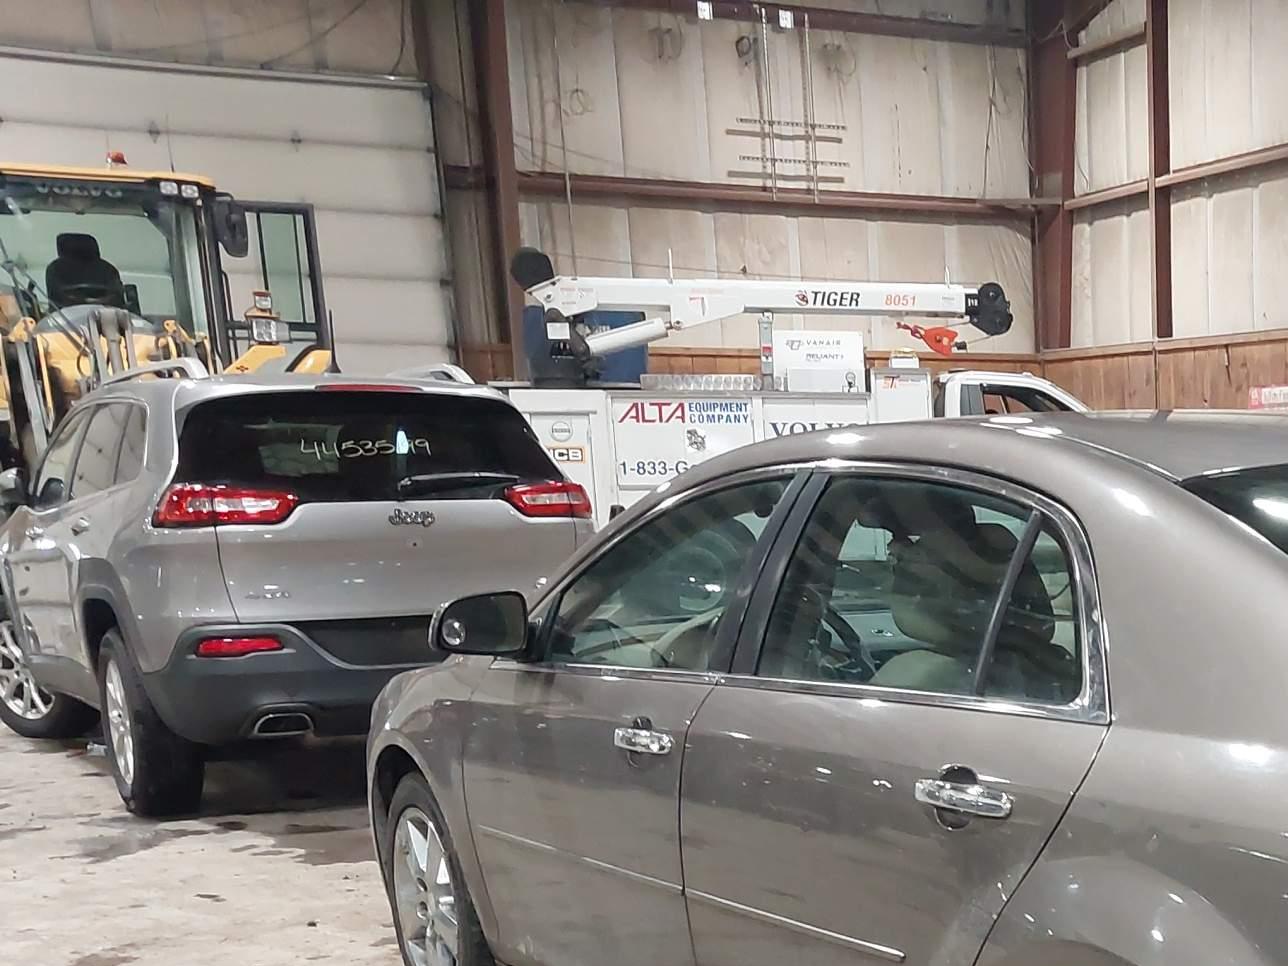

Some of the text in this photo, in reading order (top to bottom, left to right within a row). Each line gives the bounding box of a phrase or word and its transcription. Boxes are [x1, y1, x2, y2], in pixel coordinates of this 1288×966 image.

[811, 291, 916, 307] TIGER 8051
[618, 402, 686, 424] ALTA
[688, 402, 749, 413] EQUIPMENT
[689, 413, 749, 424] COMPANY
[388, 508, 436, 528] Jeep
